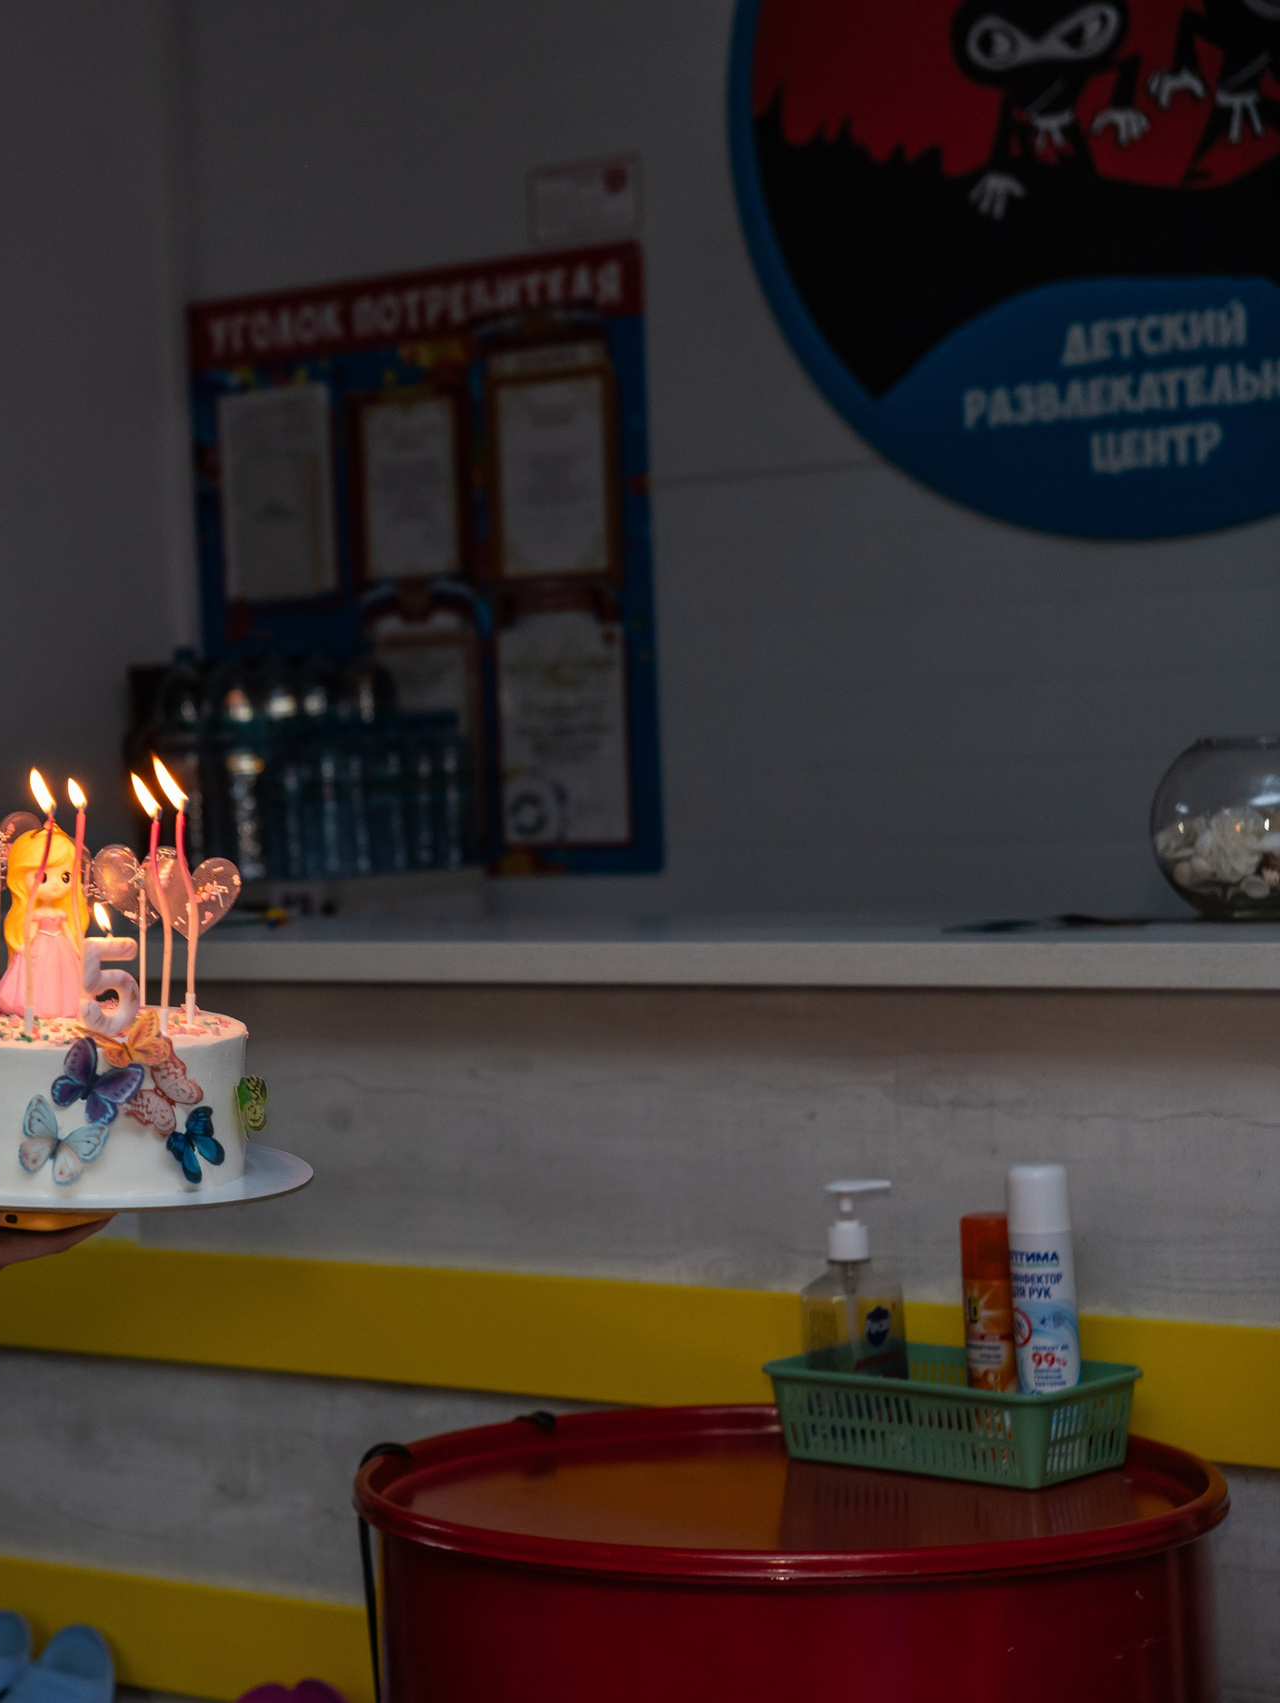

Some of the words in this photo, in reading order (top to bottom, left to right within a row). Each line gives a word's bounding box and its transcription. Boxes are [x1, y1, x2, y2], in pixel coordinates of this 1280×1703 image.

[209, 301, 343, 358] УГОЛОК
[351, 257, 622, 339] ПОТРЕБИТЕЛЯ
[1060, 298, 1249, 368] ДЕТСКИЙ
[1089, 418, 1223, 477] ЦЕНТР
[83, 937, 139, 1038] 5
[1011, 1251, 1058, 1263] ПТИМА
[1028, 1286, 1051, 1299] РУК
[1032, 1351, 1066, 1367] 99%
